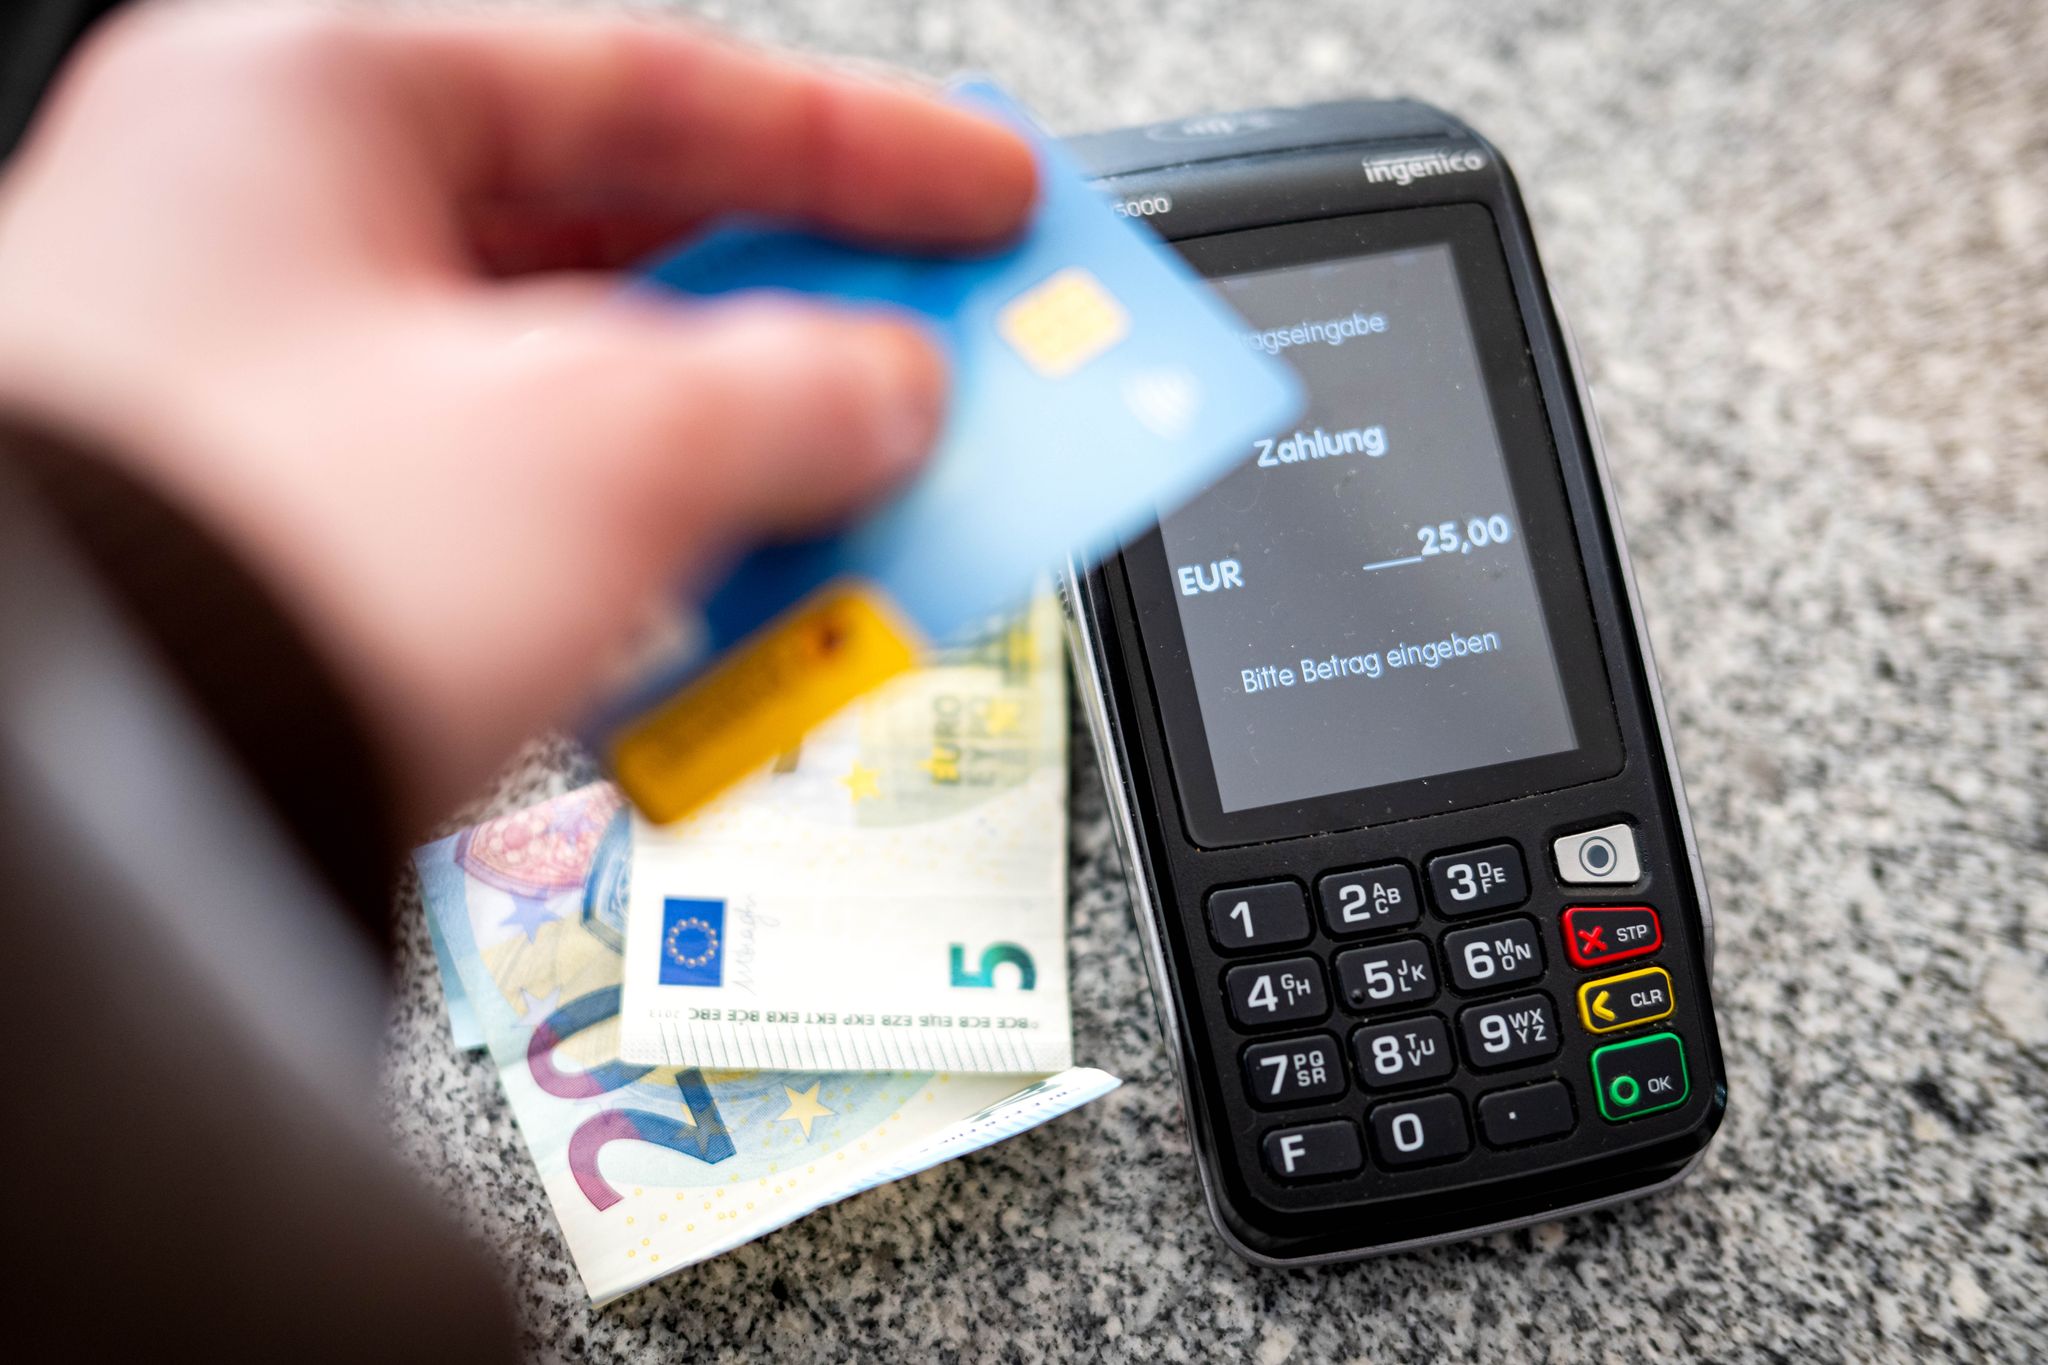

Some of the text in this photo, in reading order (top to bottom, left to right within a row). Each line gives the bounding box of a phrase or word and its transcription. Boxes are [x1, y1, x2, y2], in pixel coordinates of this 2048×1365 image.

[1362, 151, 1486, 185] ingenico
[1114, 196, 1171, 217] 5000
[1247, 312, 1387, 355] agseingabe
[1254, 424, 1387, 468] Zahlung
[1177, 558, 1244, 595] EUR
[1241, 631, 1499, 693] Bitte Betrag eingeben
[1447, 864, 1478, 901] 3
[1228, 900, 1256, 939] 1
[1338, 884, 1371, 923] 2
[1616, 923, 1649, 943] STP
[948, 940, 1037, 991] 5
[1363, 960, 1395, 1000] 5
[1463, 941, 1494, 980] 6
[688, 1006, 721, 1021] EBC
[1247, 975, 1279, 1013] 4
[1630, 988, 1664, 1008] CLR
[1479, 1015, 1511, 1054] 9
[1260, 1054, 1289, 1095] 7
[1371, 1035, 1403, 1075] 8
[1647, 1075, 1674, 1094] OK
[1280, 1134, 1306, 1173] F
